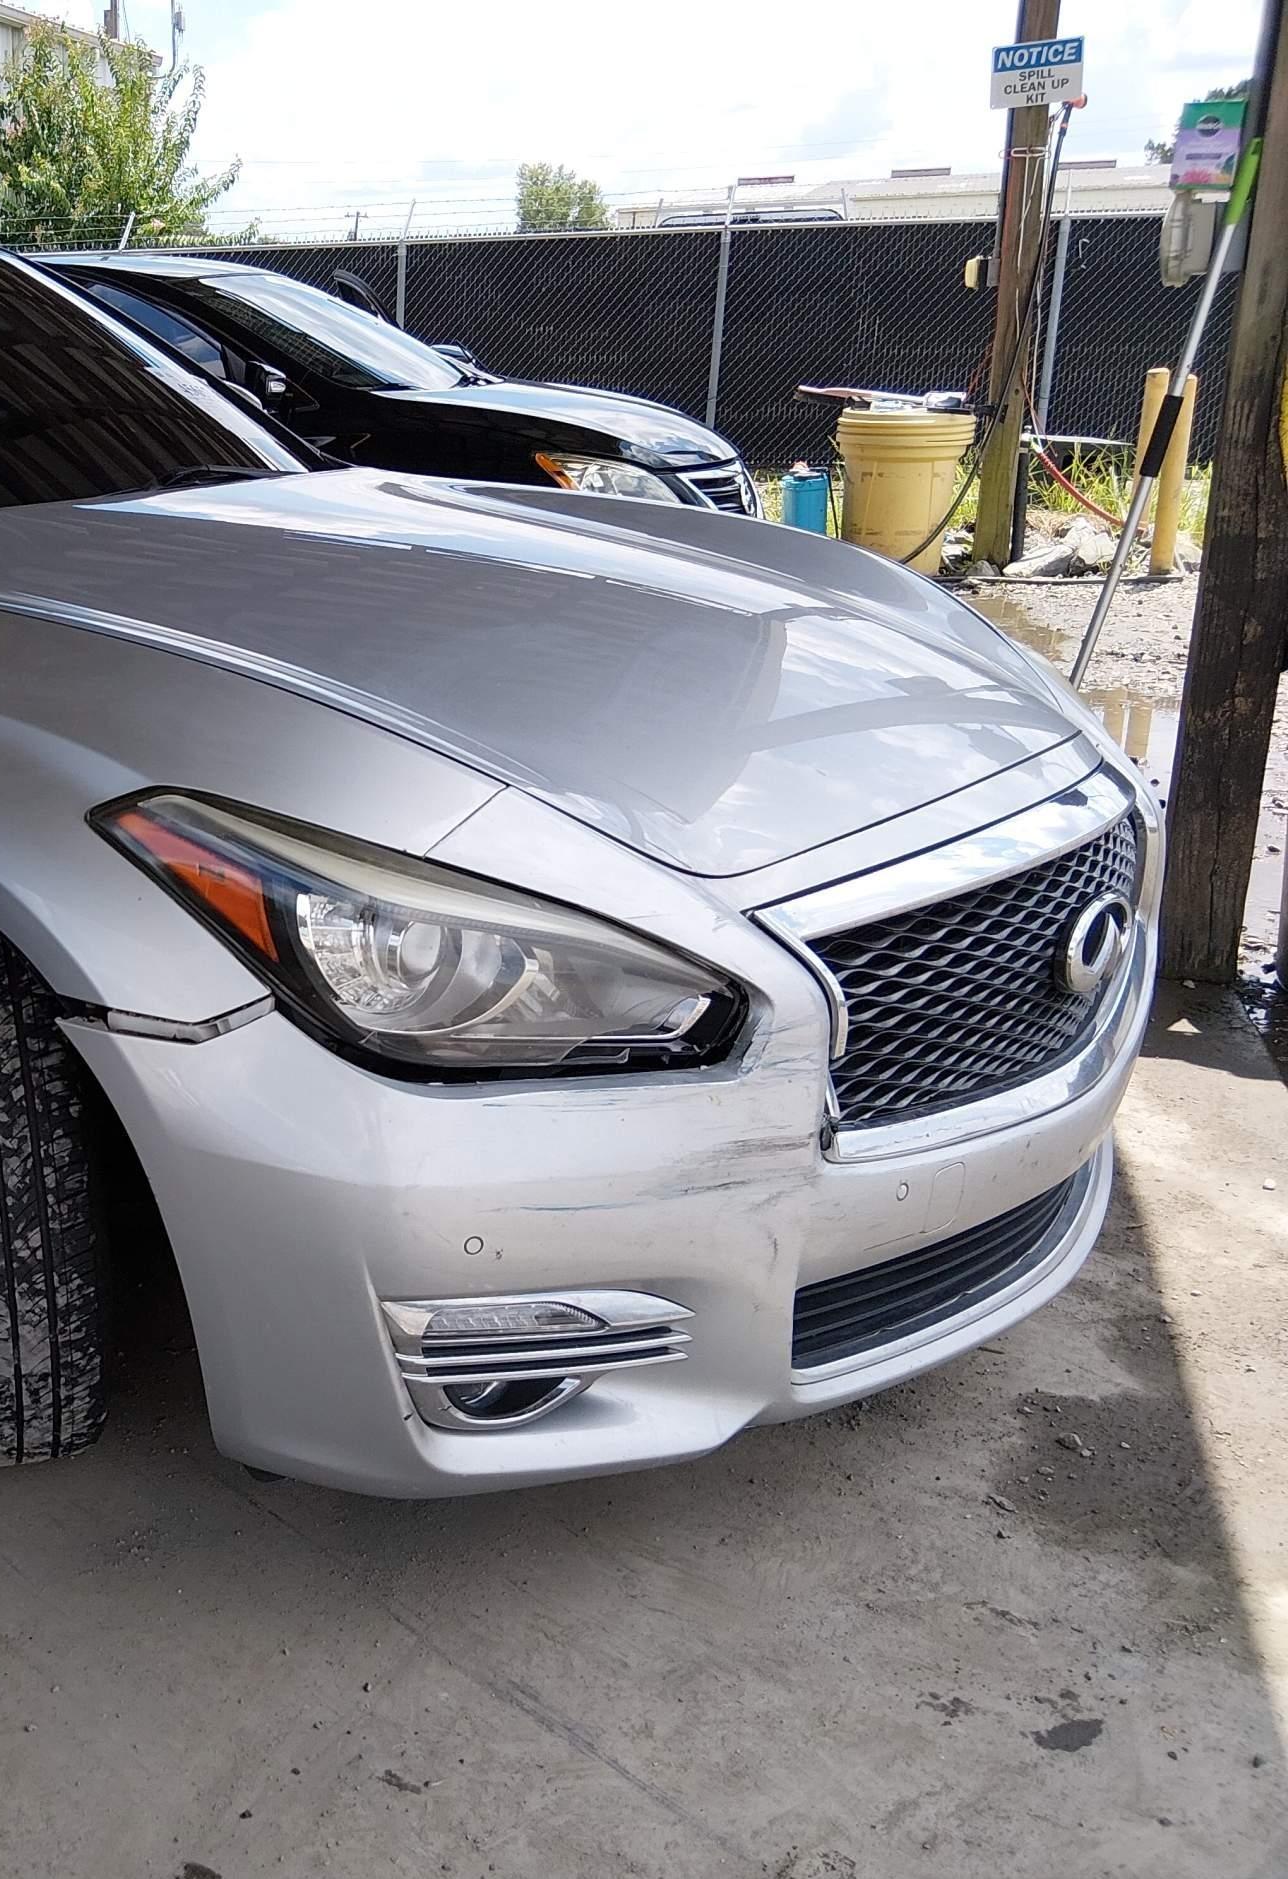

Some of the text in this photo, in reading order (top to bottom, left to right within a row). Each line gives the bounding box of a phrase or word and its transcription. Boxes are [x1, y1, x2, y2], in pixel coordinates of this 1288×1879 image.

[997, 42, 1079, 69] NOTICE
[1018, 68, 1054, 81] SPILL
[1003, 78, 1070, 95] CLEAN UP
[1025, 92, 1047, 105] KIT
